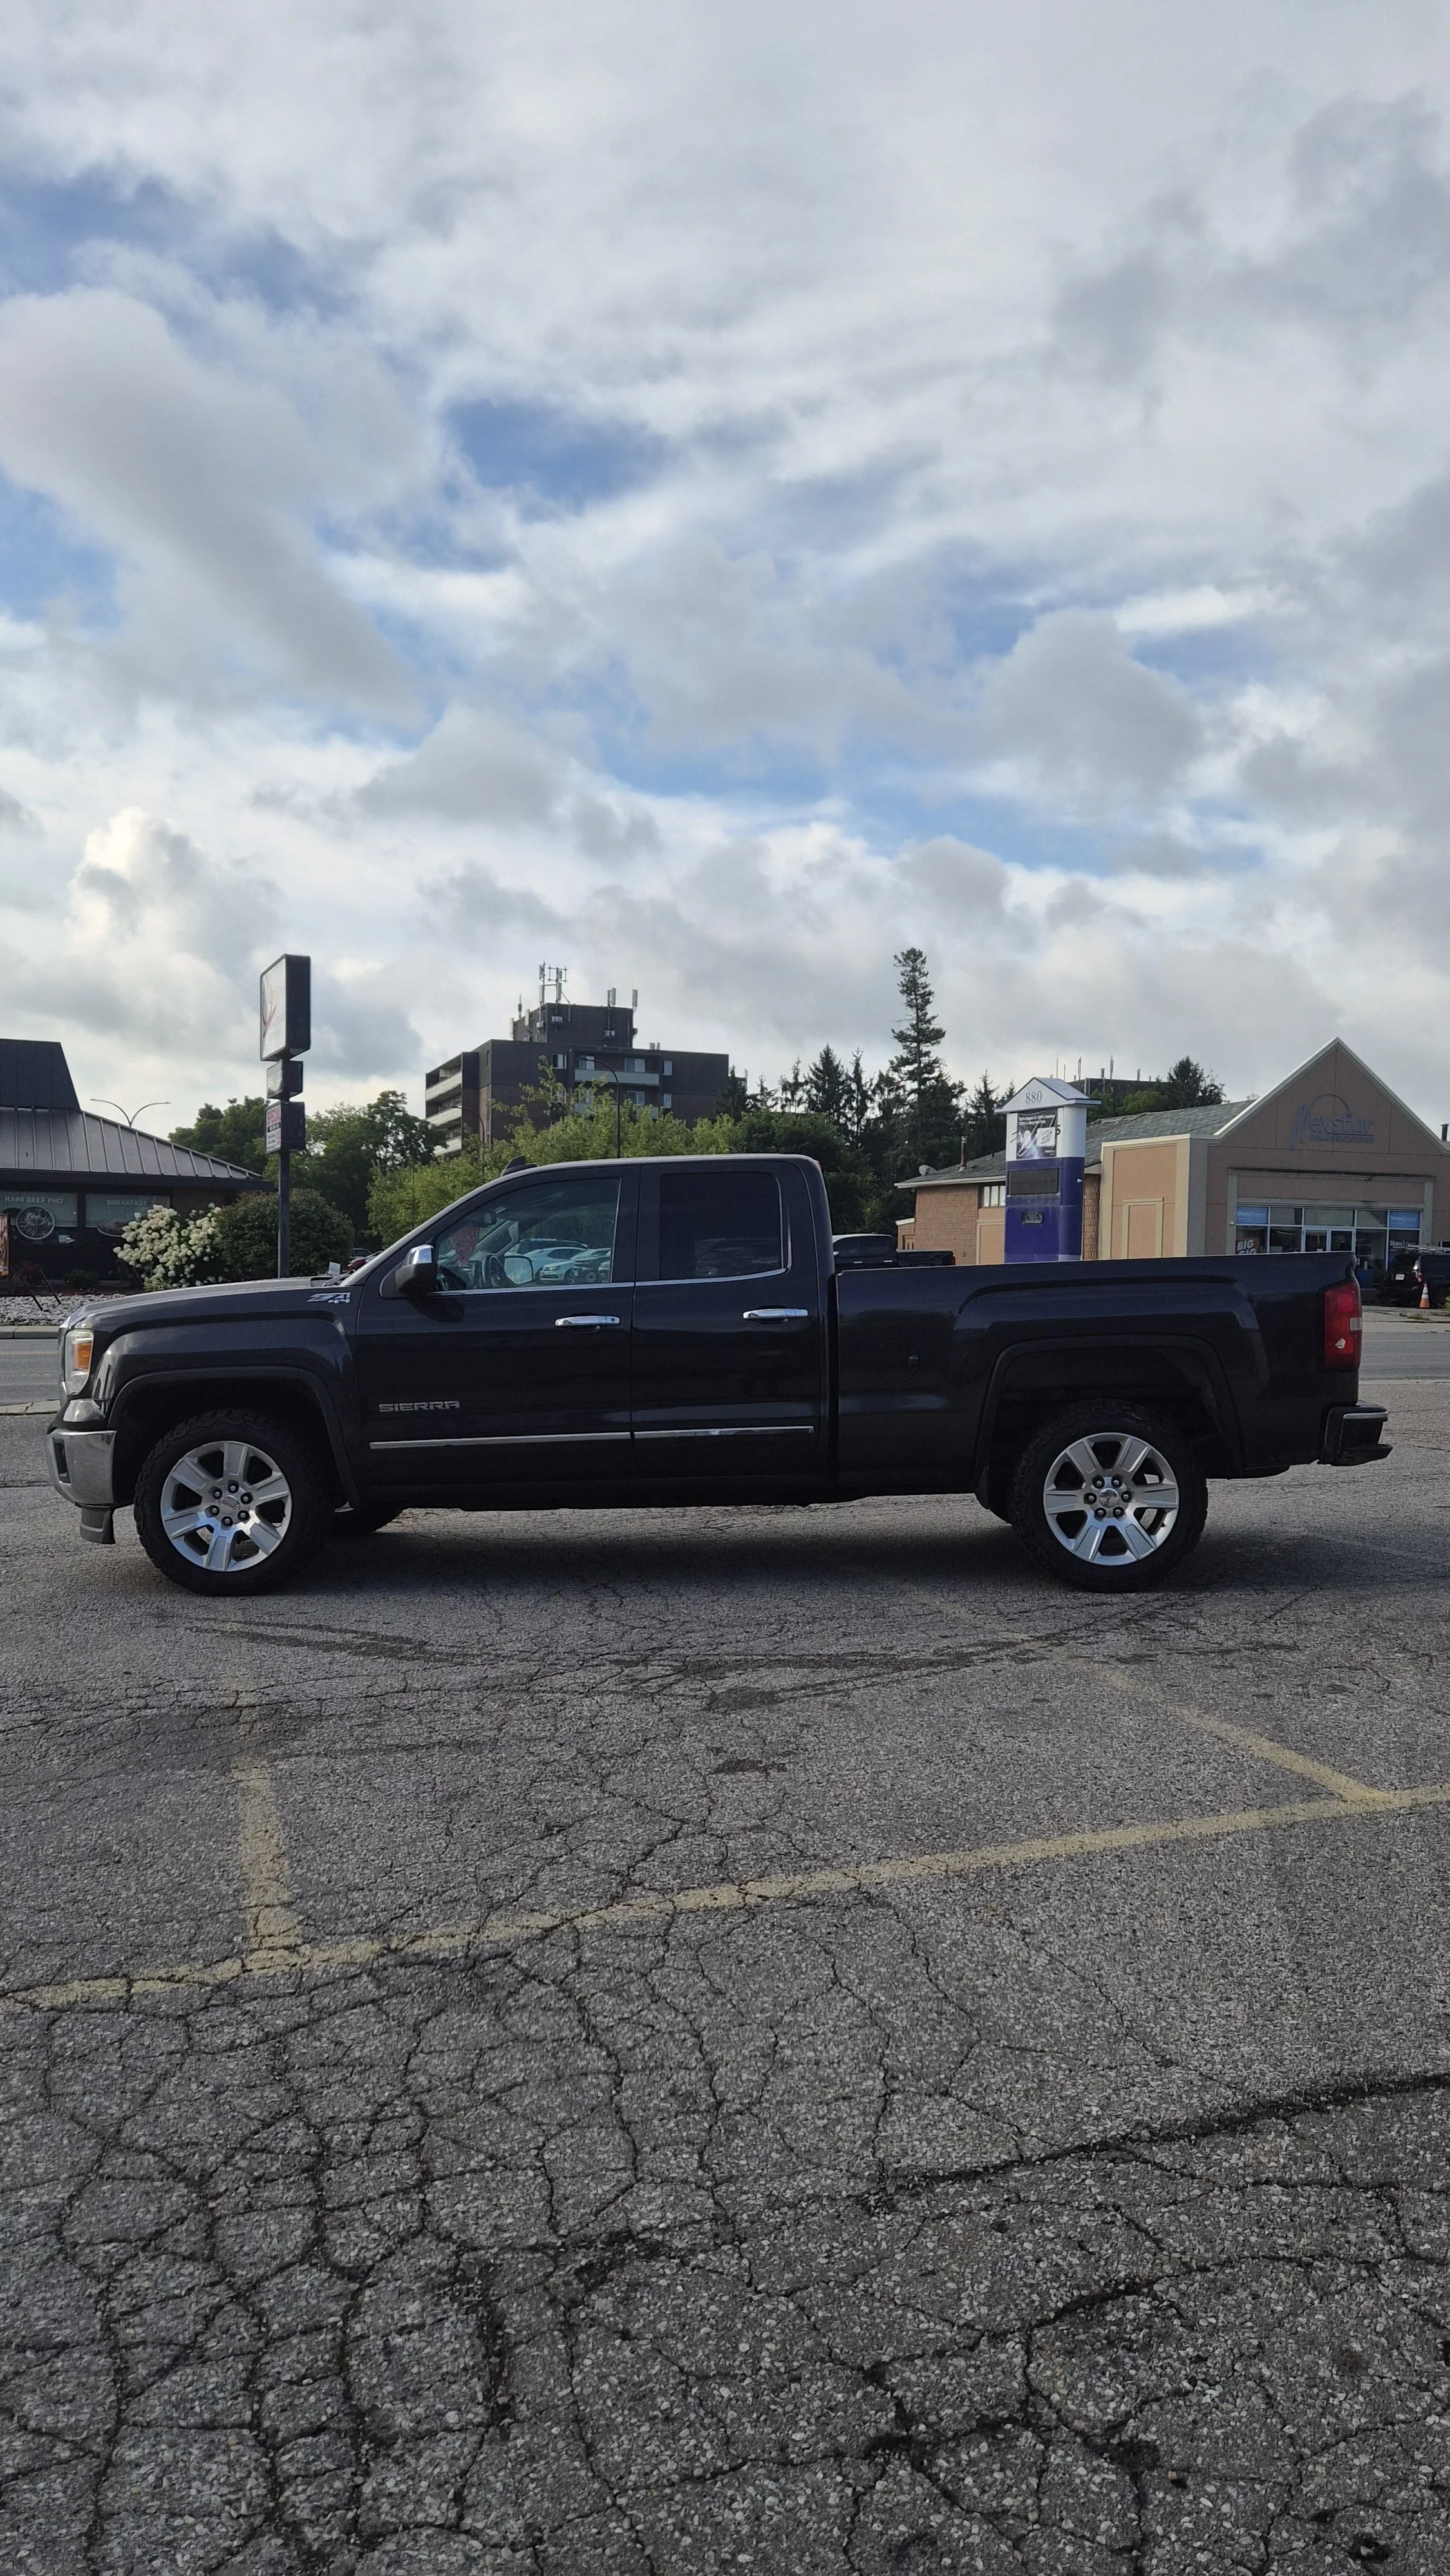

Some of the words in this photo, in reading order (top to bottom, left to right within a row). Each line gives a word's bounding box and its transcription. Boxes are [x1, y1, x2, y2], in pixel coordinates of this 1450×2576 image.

[1026, 1091, 1042, 1103] 880
[1237, 1240, 1254, 1251] BIG
[379, 1401, 460, 1412] SIERRA
[221, 1500, 239, 1511] GMC
